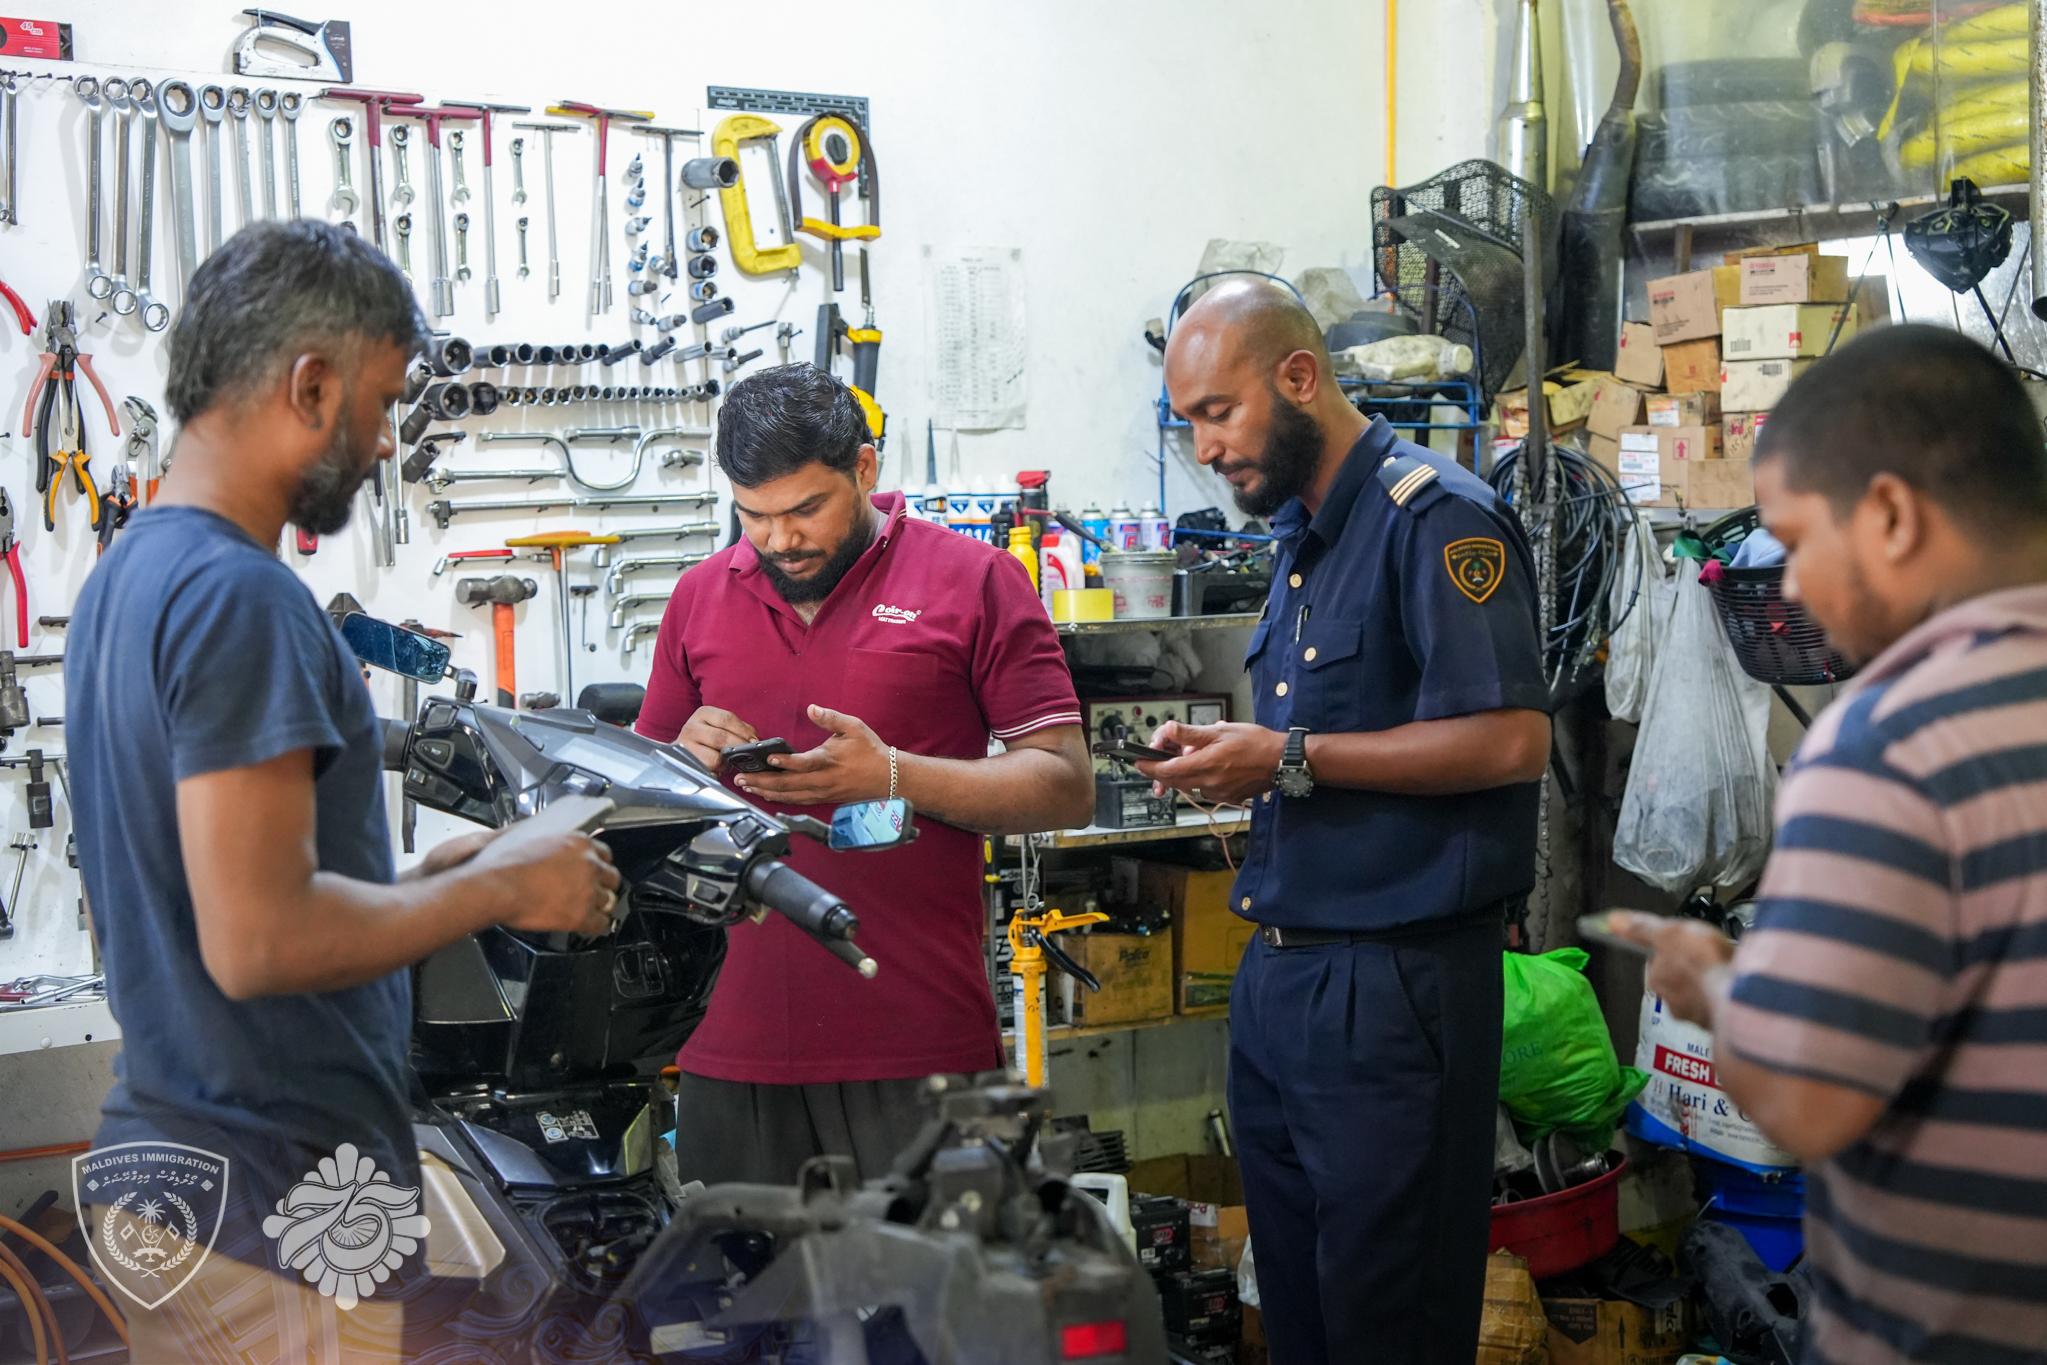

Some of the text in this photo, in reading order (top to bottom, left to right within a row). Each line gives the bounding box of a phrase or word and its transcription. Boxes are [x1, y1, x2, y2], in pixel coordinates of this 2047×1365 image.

[1664, 1052, 1711, 1083] FRESH
[1668, 1082, 1708, 1111] Hari
[1713, 1097, 1729, 1117] &
